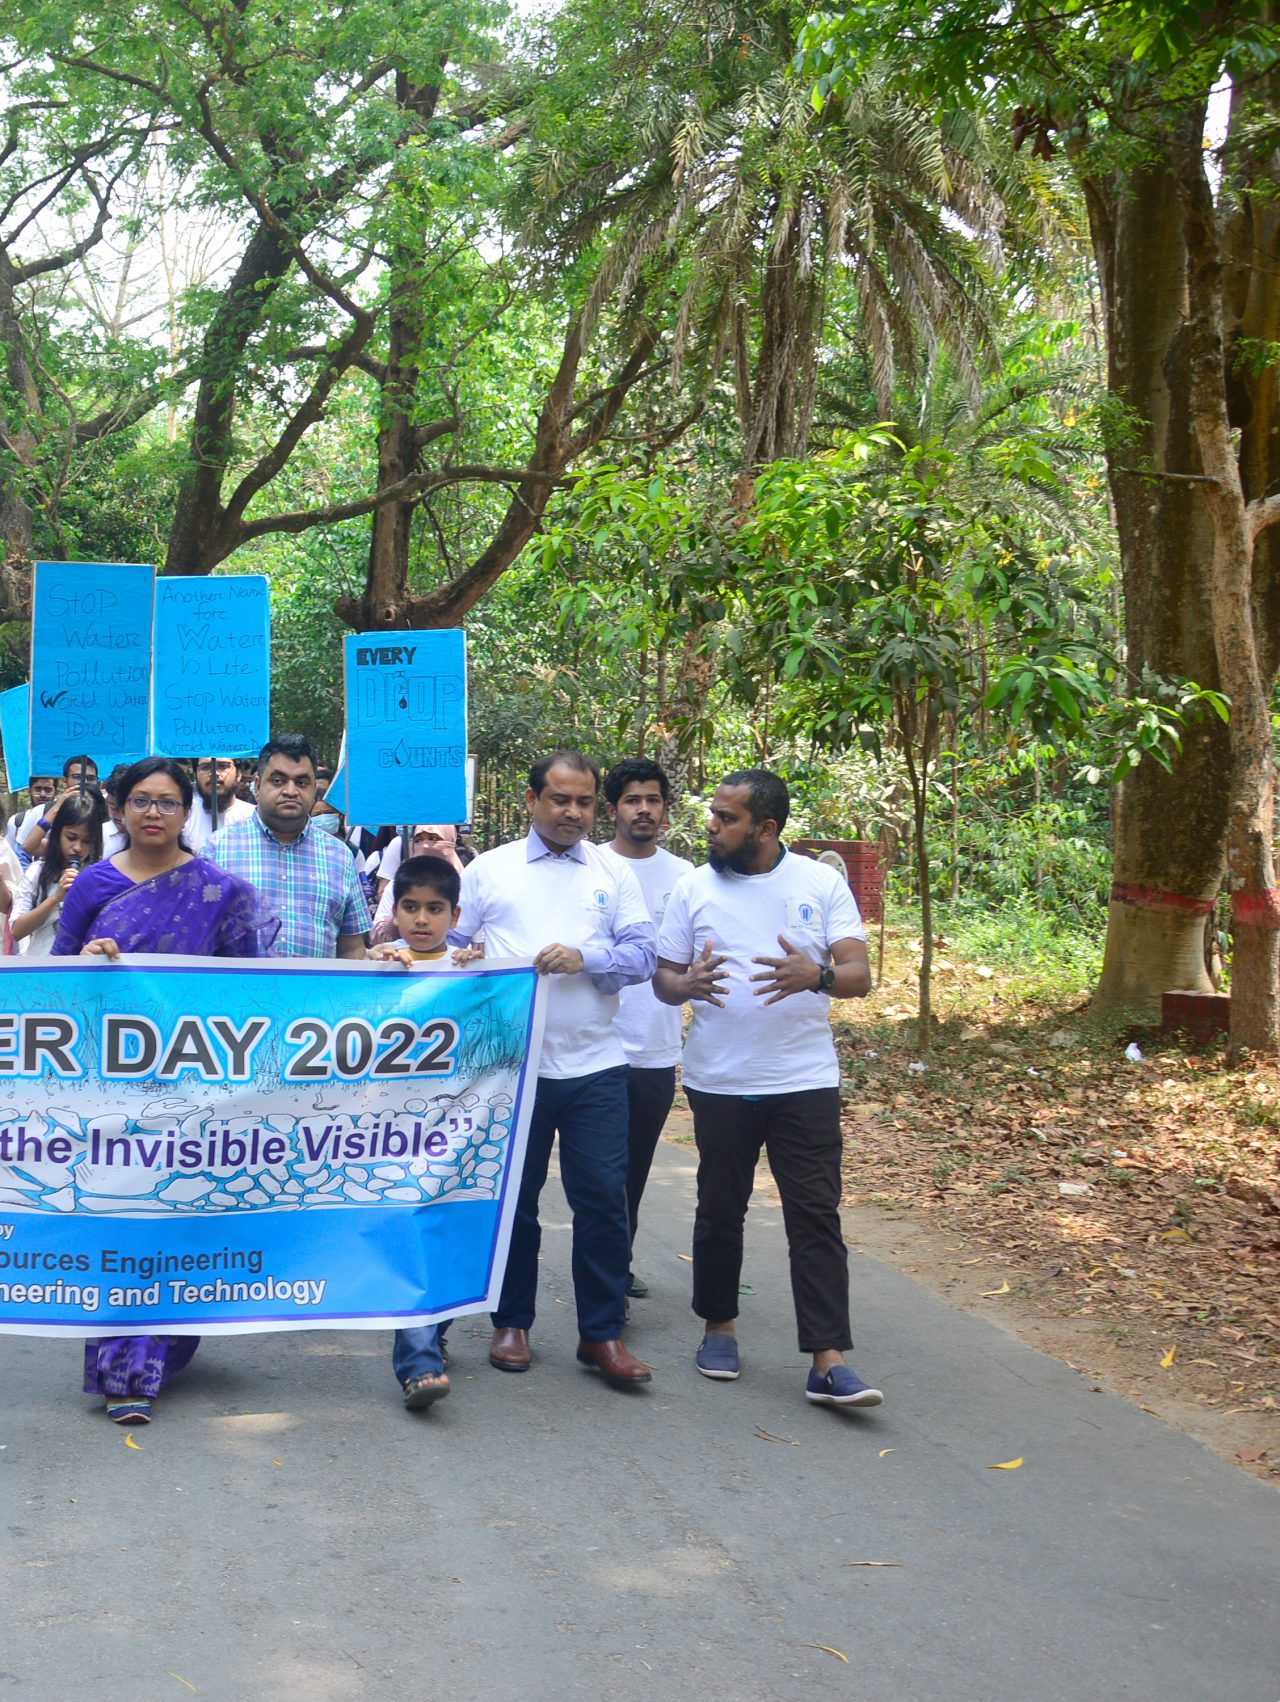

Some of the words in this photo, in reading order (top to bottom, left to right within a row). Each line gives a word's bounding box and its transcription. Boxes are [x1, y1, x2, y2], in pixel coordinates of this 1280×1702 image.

[229, 584, 266, 601] Name
[61, 620, 141, 649] Water
[176, 623, 265, 651] Water
[356, 646, 418, 667] EVERY
[56, 660, 149, 688] Pollution
[40, 690, 98, 710] World
[64, 711, 126, 749] Day
[106, 1017, 267, 1077] DAY
[287, 1020, 457, 1078] 2022
[90, 1128, 286, 1169] Invisible
[302, 1117, 474, 1162] Visible”
[101, 1246, 264, 1280] Engineering
[108, 1280, 161, 1308] and
[167, 1274, 328, 1306] Technology
